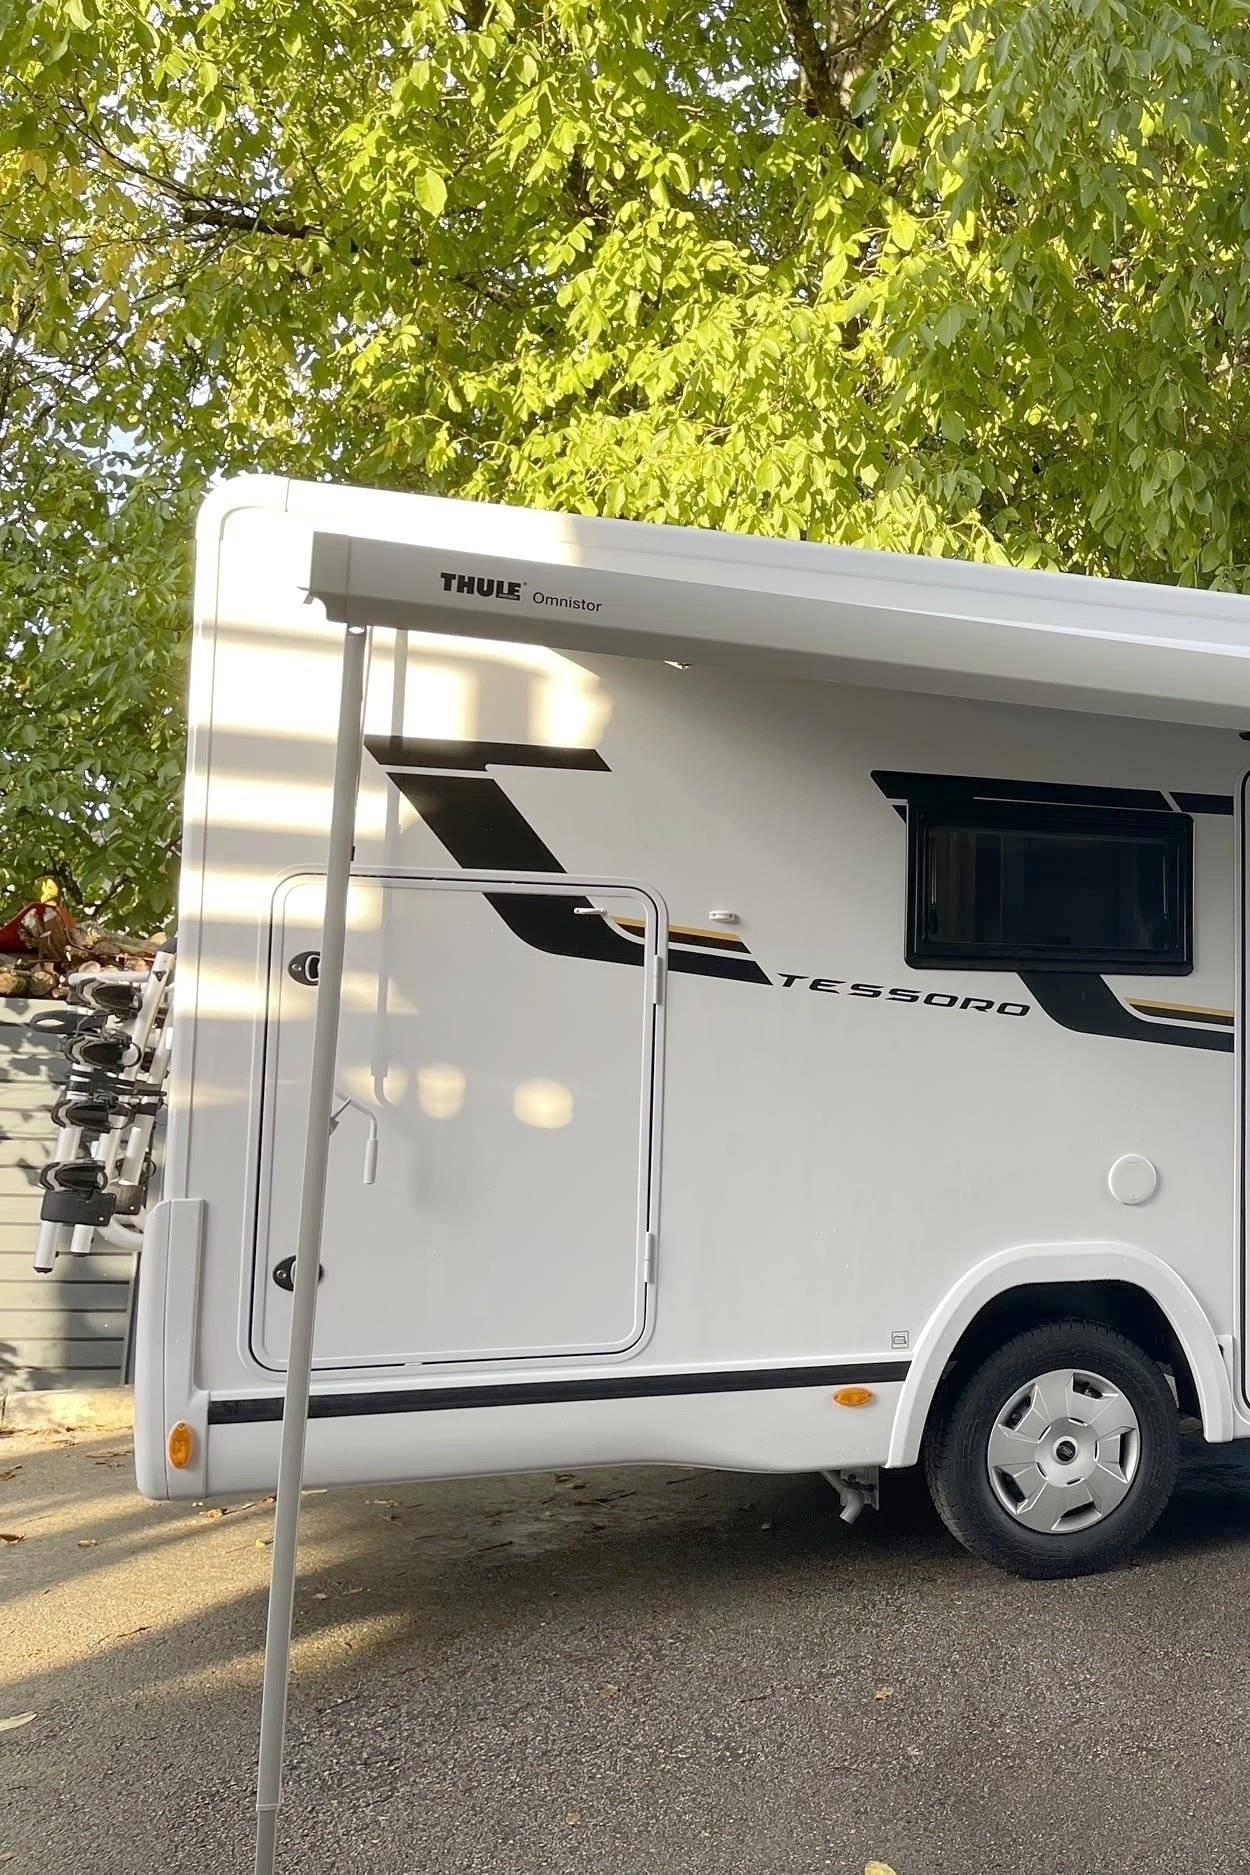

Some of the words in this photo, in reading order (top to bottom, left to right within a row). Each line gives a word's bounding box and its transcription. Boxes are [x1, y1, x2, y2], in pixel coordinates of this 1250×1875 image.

[440, 572, 521, 601] THULE
[532, 591, 602, 612] Omnistor
[777, 972, 1031, 1017] TESSORO
